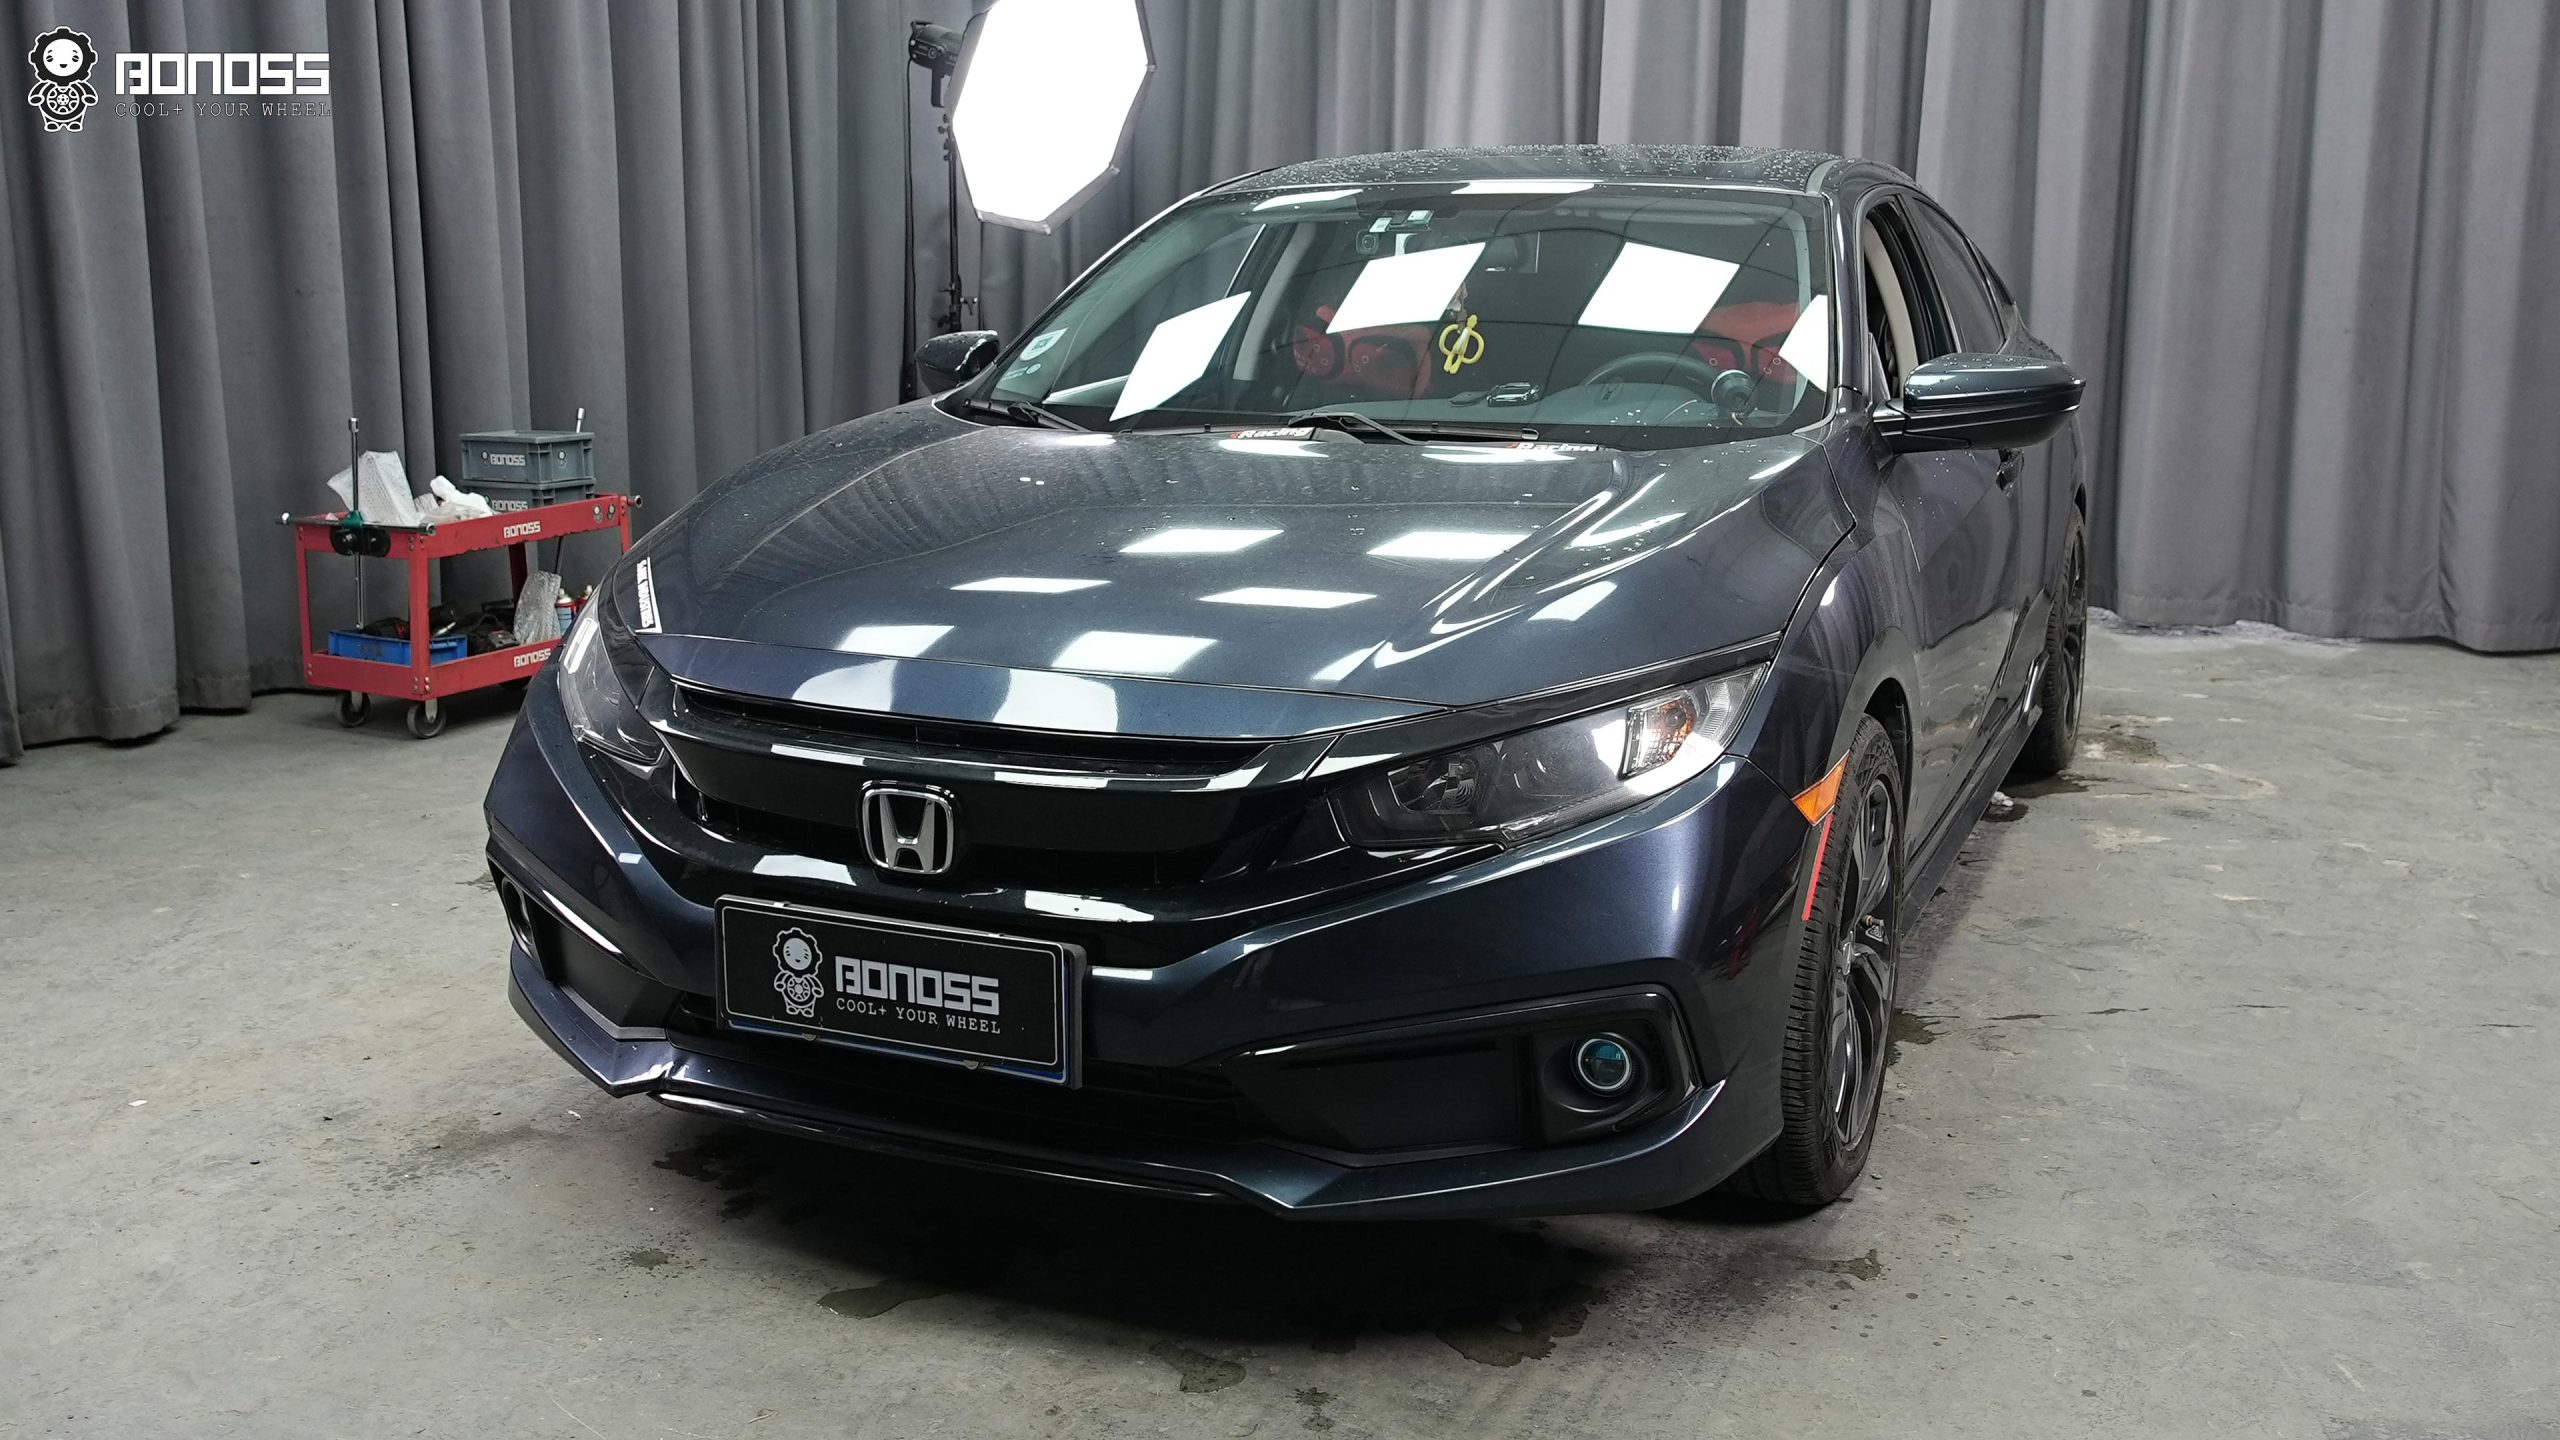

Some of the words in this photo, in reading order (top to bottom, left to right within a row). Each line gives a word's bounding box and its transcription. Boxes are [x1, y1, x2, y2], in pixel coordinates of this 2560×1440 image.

[490, 454, 526, 466] BONOSS
[504, 521, 541, 538] BONOSS
[514, 648, 551, 668] BONOSS
[835, 955, 999, 1016] BONOSS
[836, 997, 887, 1016] COOL+
[895, 1006, 938, 1025] YOUR
[946, 1014, 1000, 1034] WHEEL
